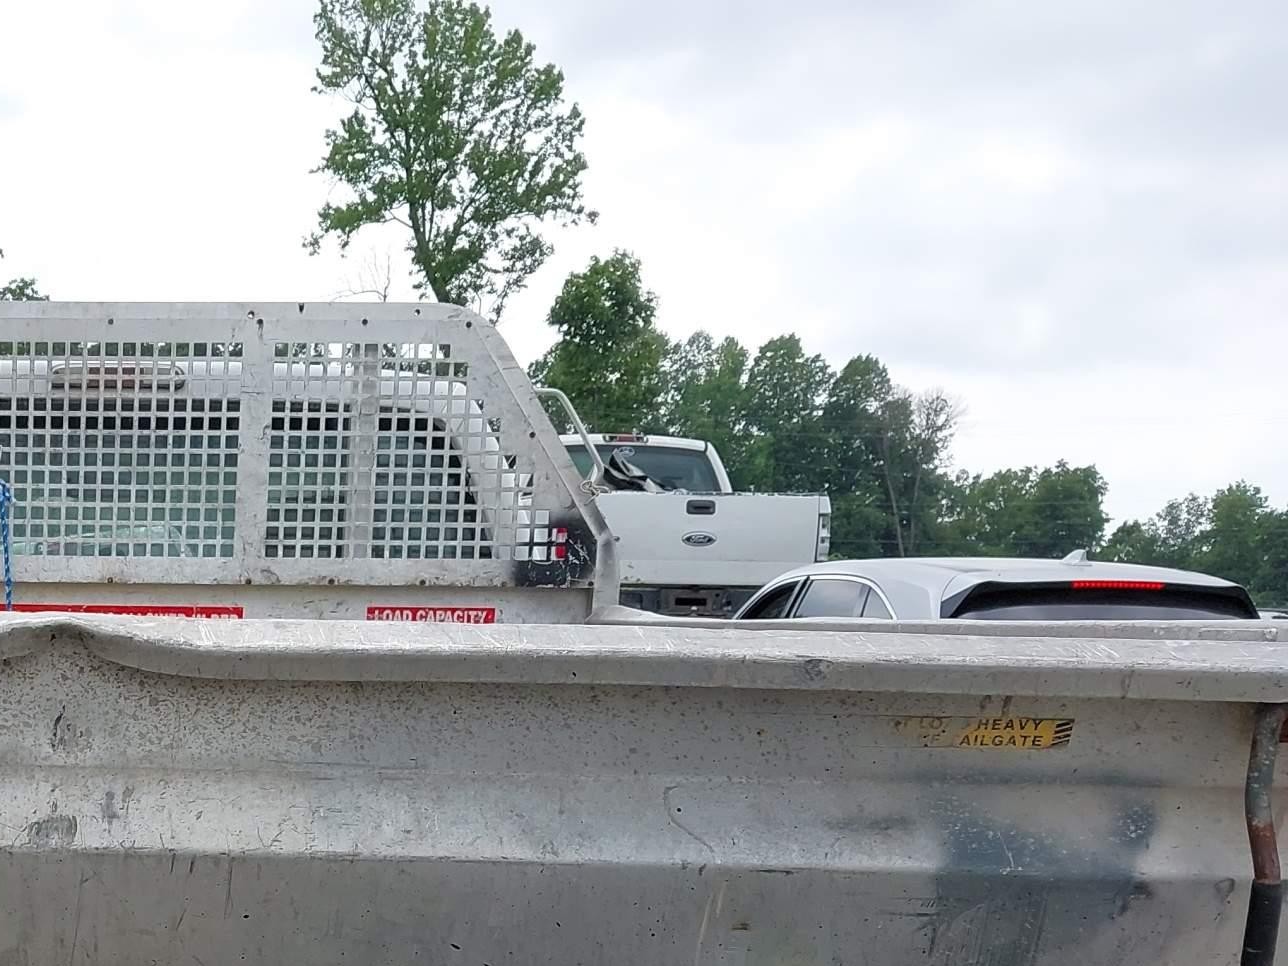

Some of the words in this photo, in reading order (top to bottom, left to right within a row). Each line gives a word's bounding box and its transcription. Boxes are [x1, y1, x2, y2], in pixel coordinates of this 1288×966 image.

[416, 608, 486, 623] CAPACITY
[975, 718, 1043, 731] HEAVY
[960, 734, 1043, 747] AILGATE
